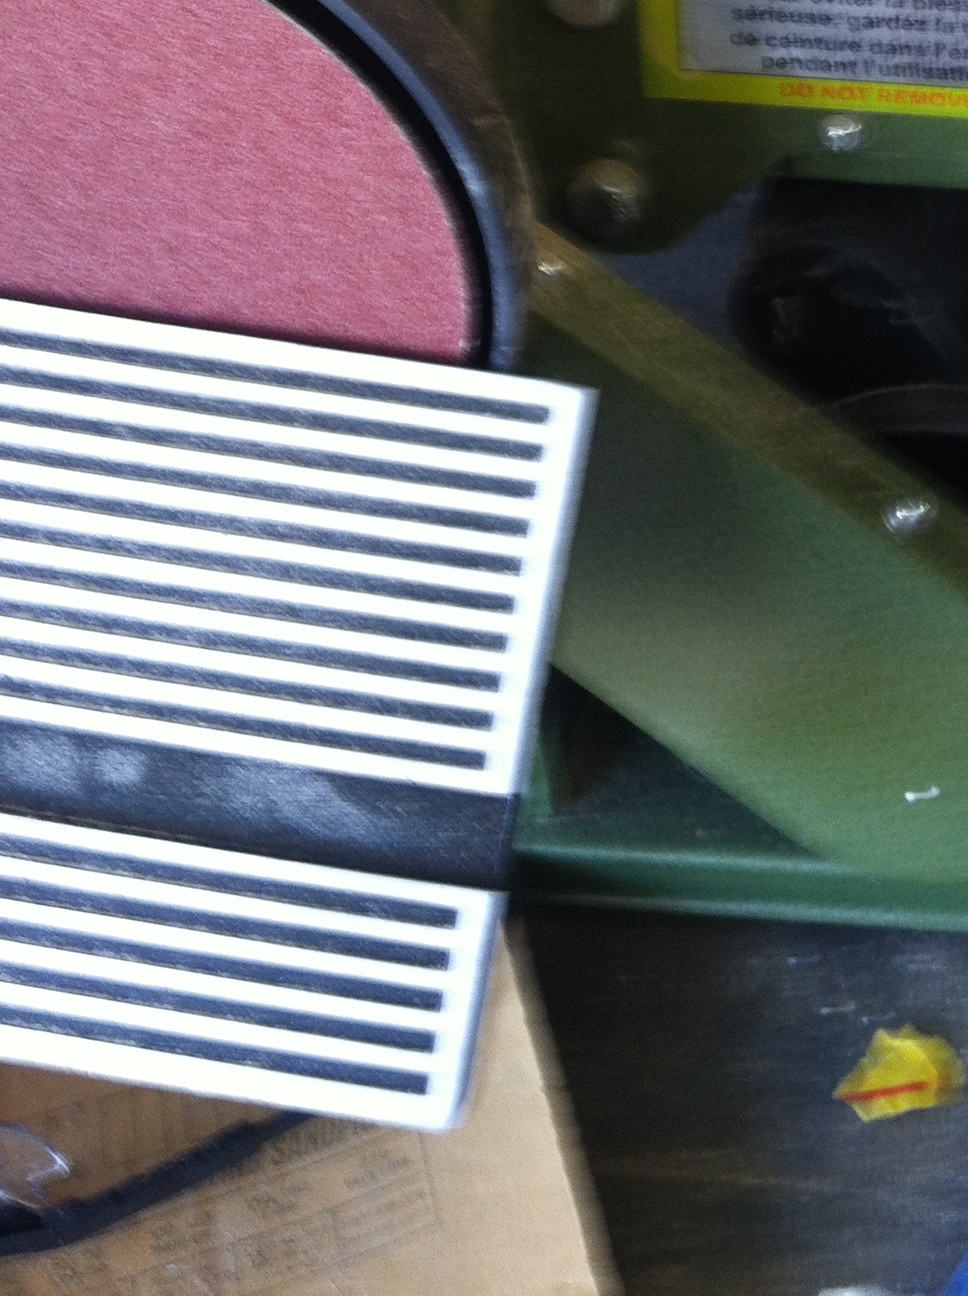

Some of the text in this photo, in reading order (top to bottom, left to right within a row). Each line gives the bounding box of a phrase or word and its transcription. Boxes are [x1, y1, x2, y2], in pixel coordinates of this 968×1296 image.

[730, 32, 758, 47] de
[779, 82, 814, 98] DO
[820, 85, 867, 101] NOT
